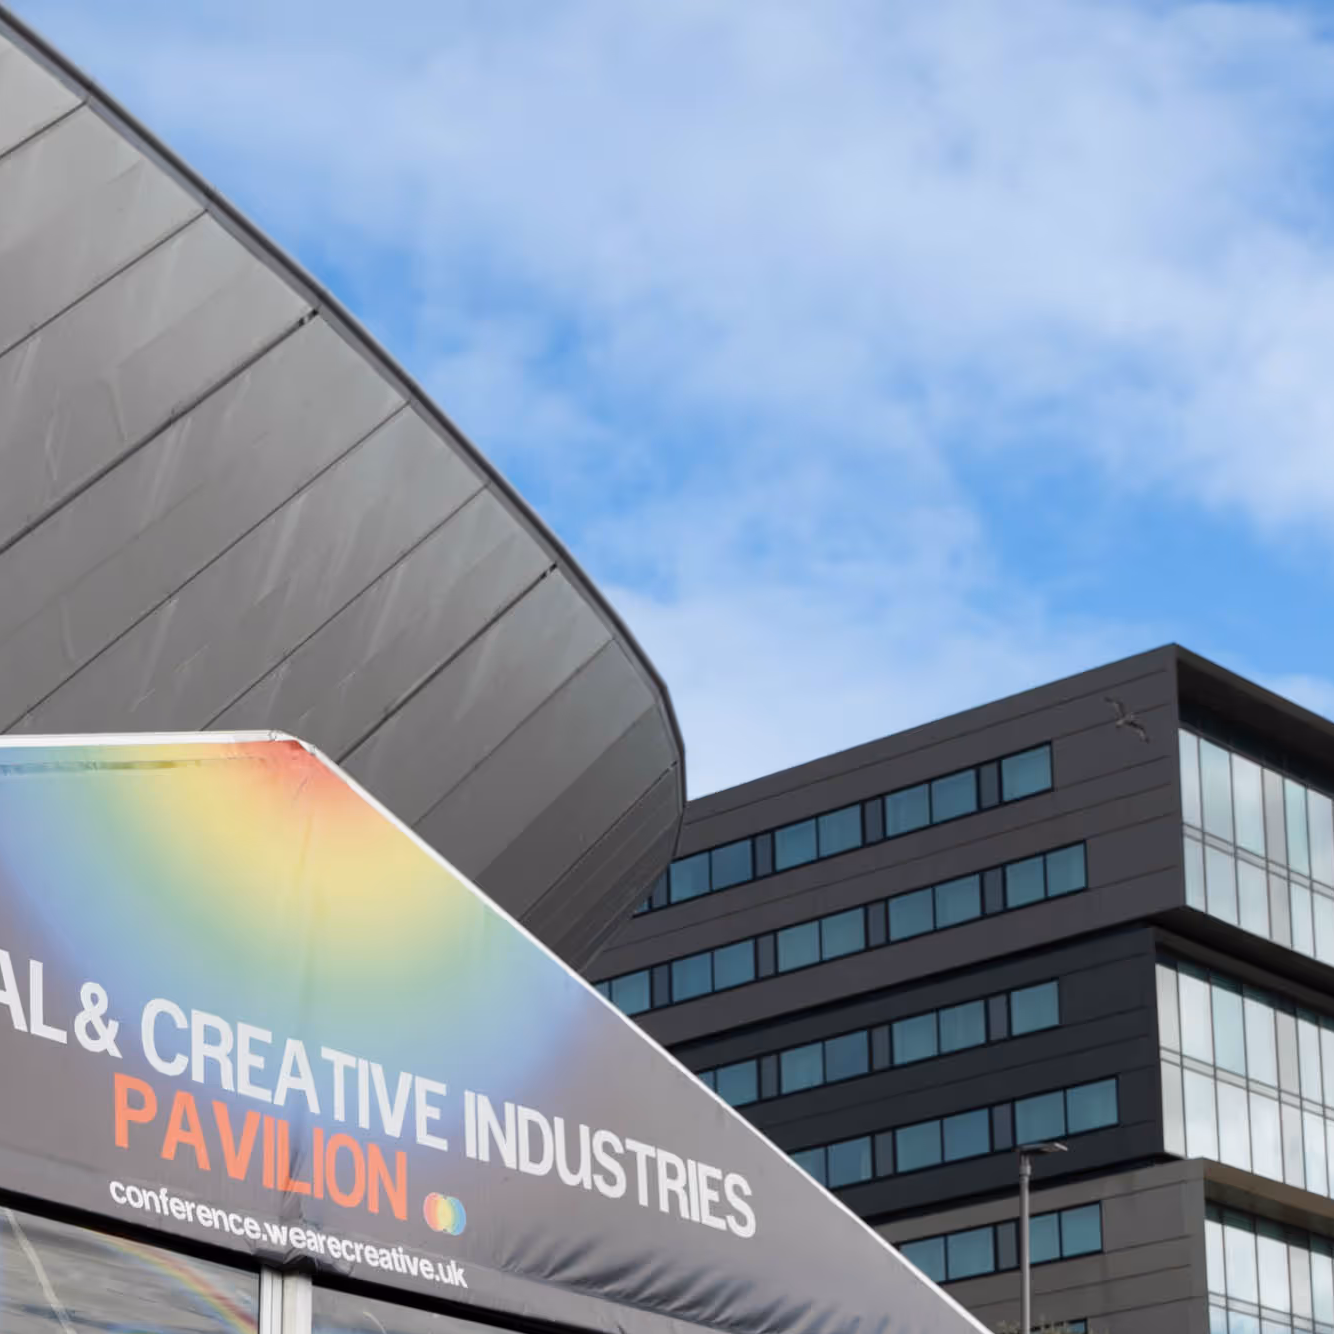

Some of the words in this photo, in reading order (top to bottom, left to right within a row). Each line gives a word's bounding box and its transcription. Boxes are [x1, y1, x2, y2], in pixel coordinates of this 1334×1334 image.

[74, 982, 123, 1058] &
[141, 998, 448, 1152] CREATIVE
[464, 1090, 755, 1239] INDUSTRIES
[113, 1073, 408, 1221] PAVILION
[109, 1179, 469, 1289] conference.wearecreative.uk
